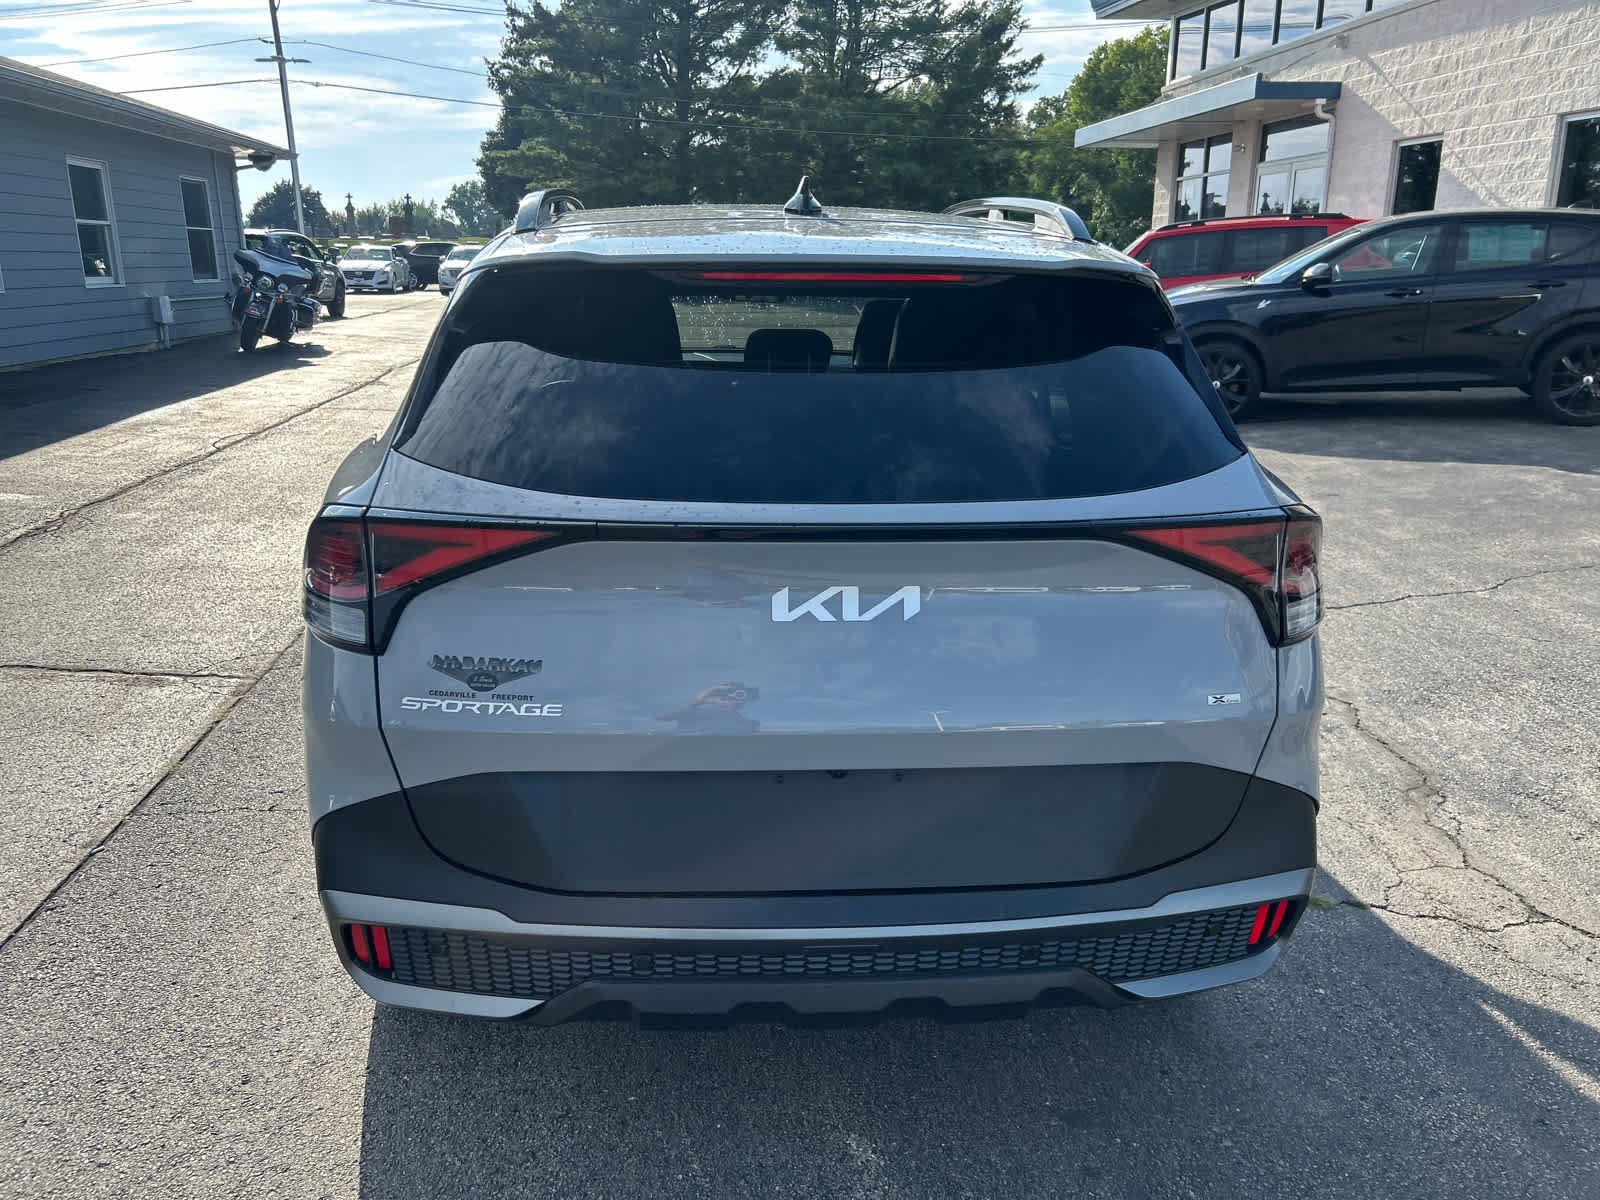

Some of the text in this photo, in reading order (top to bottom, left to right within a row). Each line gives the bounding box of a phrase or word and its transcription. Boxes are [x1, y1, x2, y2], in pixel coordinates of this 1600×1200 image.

[771, 585, 921, 622] KIA
[428, 689, 535, 702] CEDARVILLE FREEPORT
[399, 696, 563, 717] SPORTAGE
